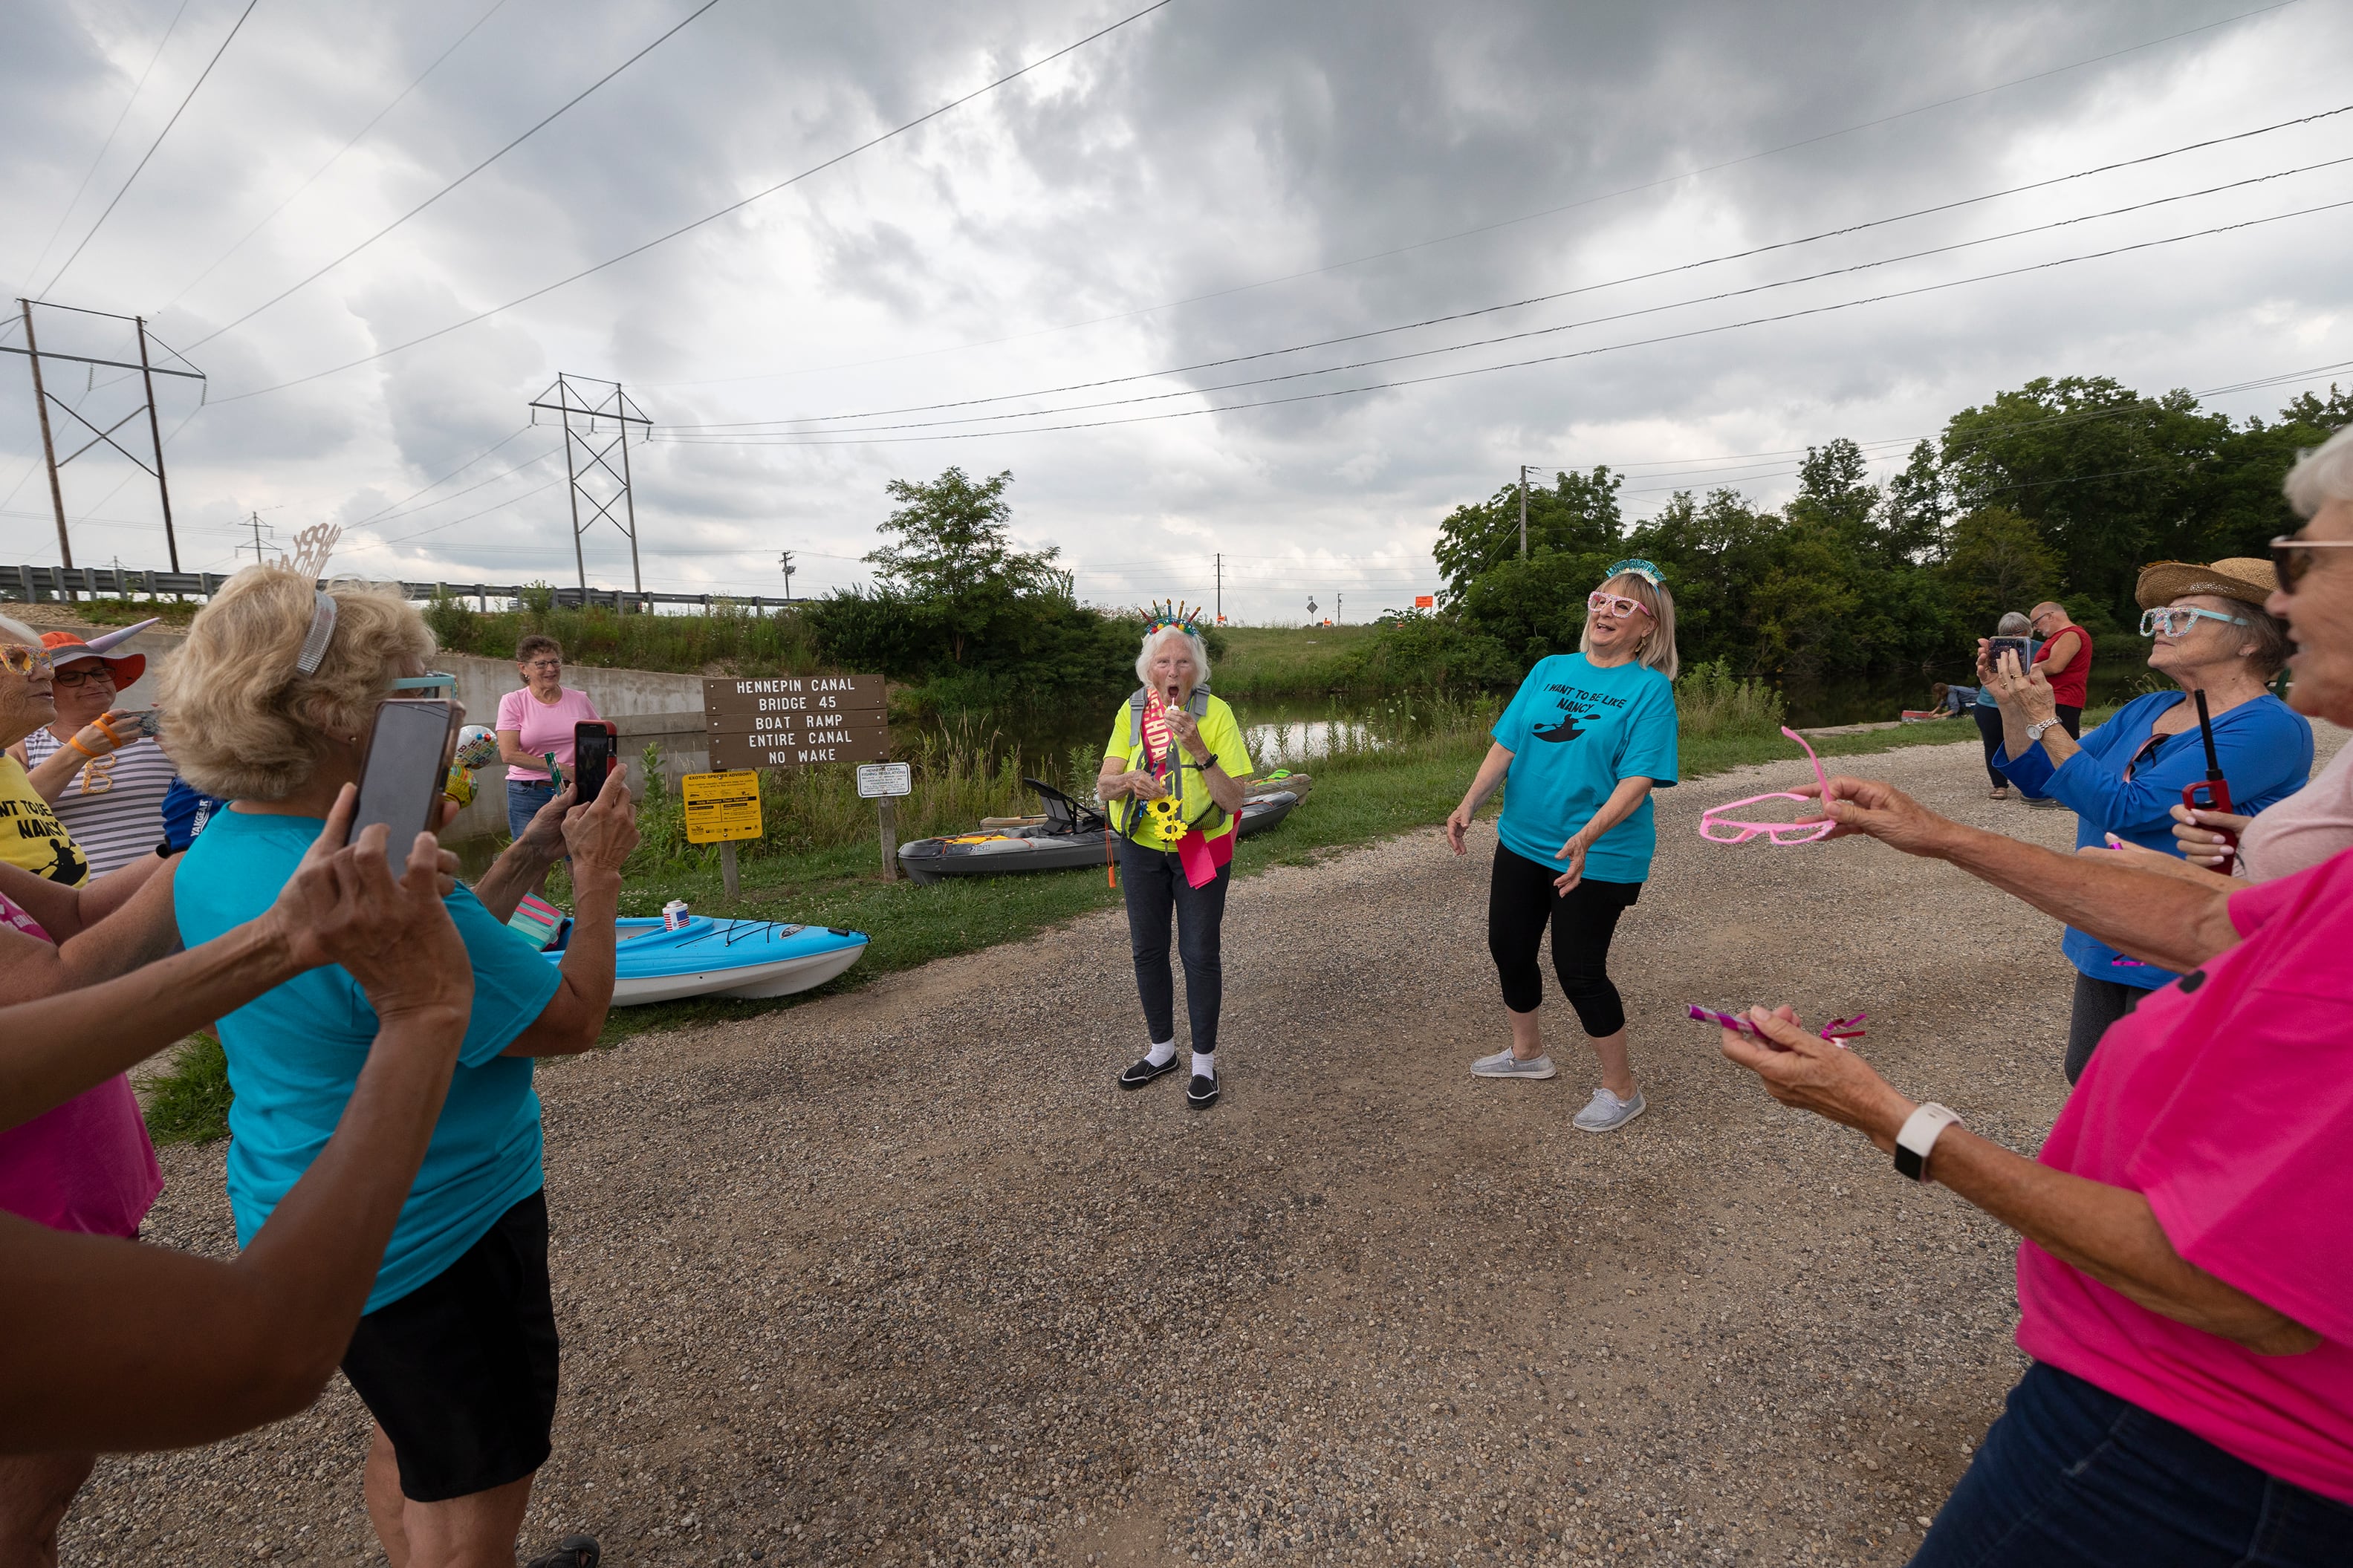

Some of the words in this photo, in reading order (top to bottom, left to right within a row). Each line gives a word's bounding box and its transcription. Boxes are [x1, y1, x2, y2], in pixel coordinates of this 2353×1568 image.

[736, 679, 802, 694] HENNEPIN
[811, 677, 855, 692] CANAL
[759, 697, 807, 711] BRIDGE
[819, 695, 837, 709] 45
[1543, 683, 1551, 692] I
[1548, 683, 1575, 696] WANT
[1575, 689, 1590, 700] TO
[1588, 693, 1604, 702] BE
[1600, 695, 1627, 709] LIKE
[1556, 697, 1595, 713] NANCY
[755, 716, 791, 730] BOAT
[806, 714, 843, 728] RAMP
[749, 732, 796, 748] ENTIRE
[808, 730, 852, 744] CANAL
[769, 751, 785, 764] NO
[798, 748, 836, 763] WAKE
[0, 800, 19, 817] NT
[19, 800, 39, 815] TO
[190, 799, 209, 837] YAKGEAR
